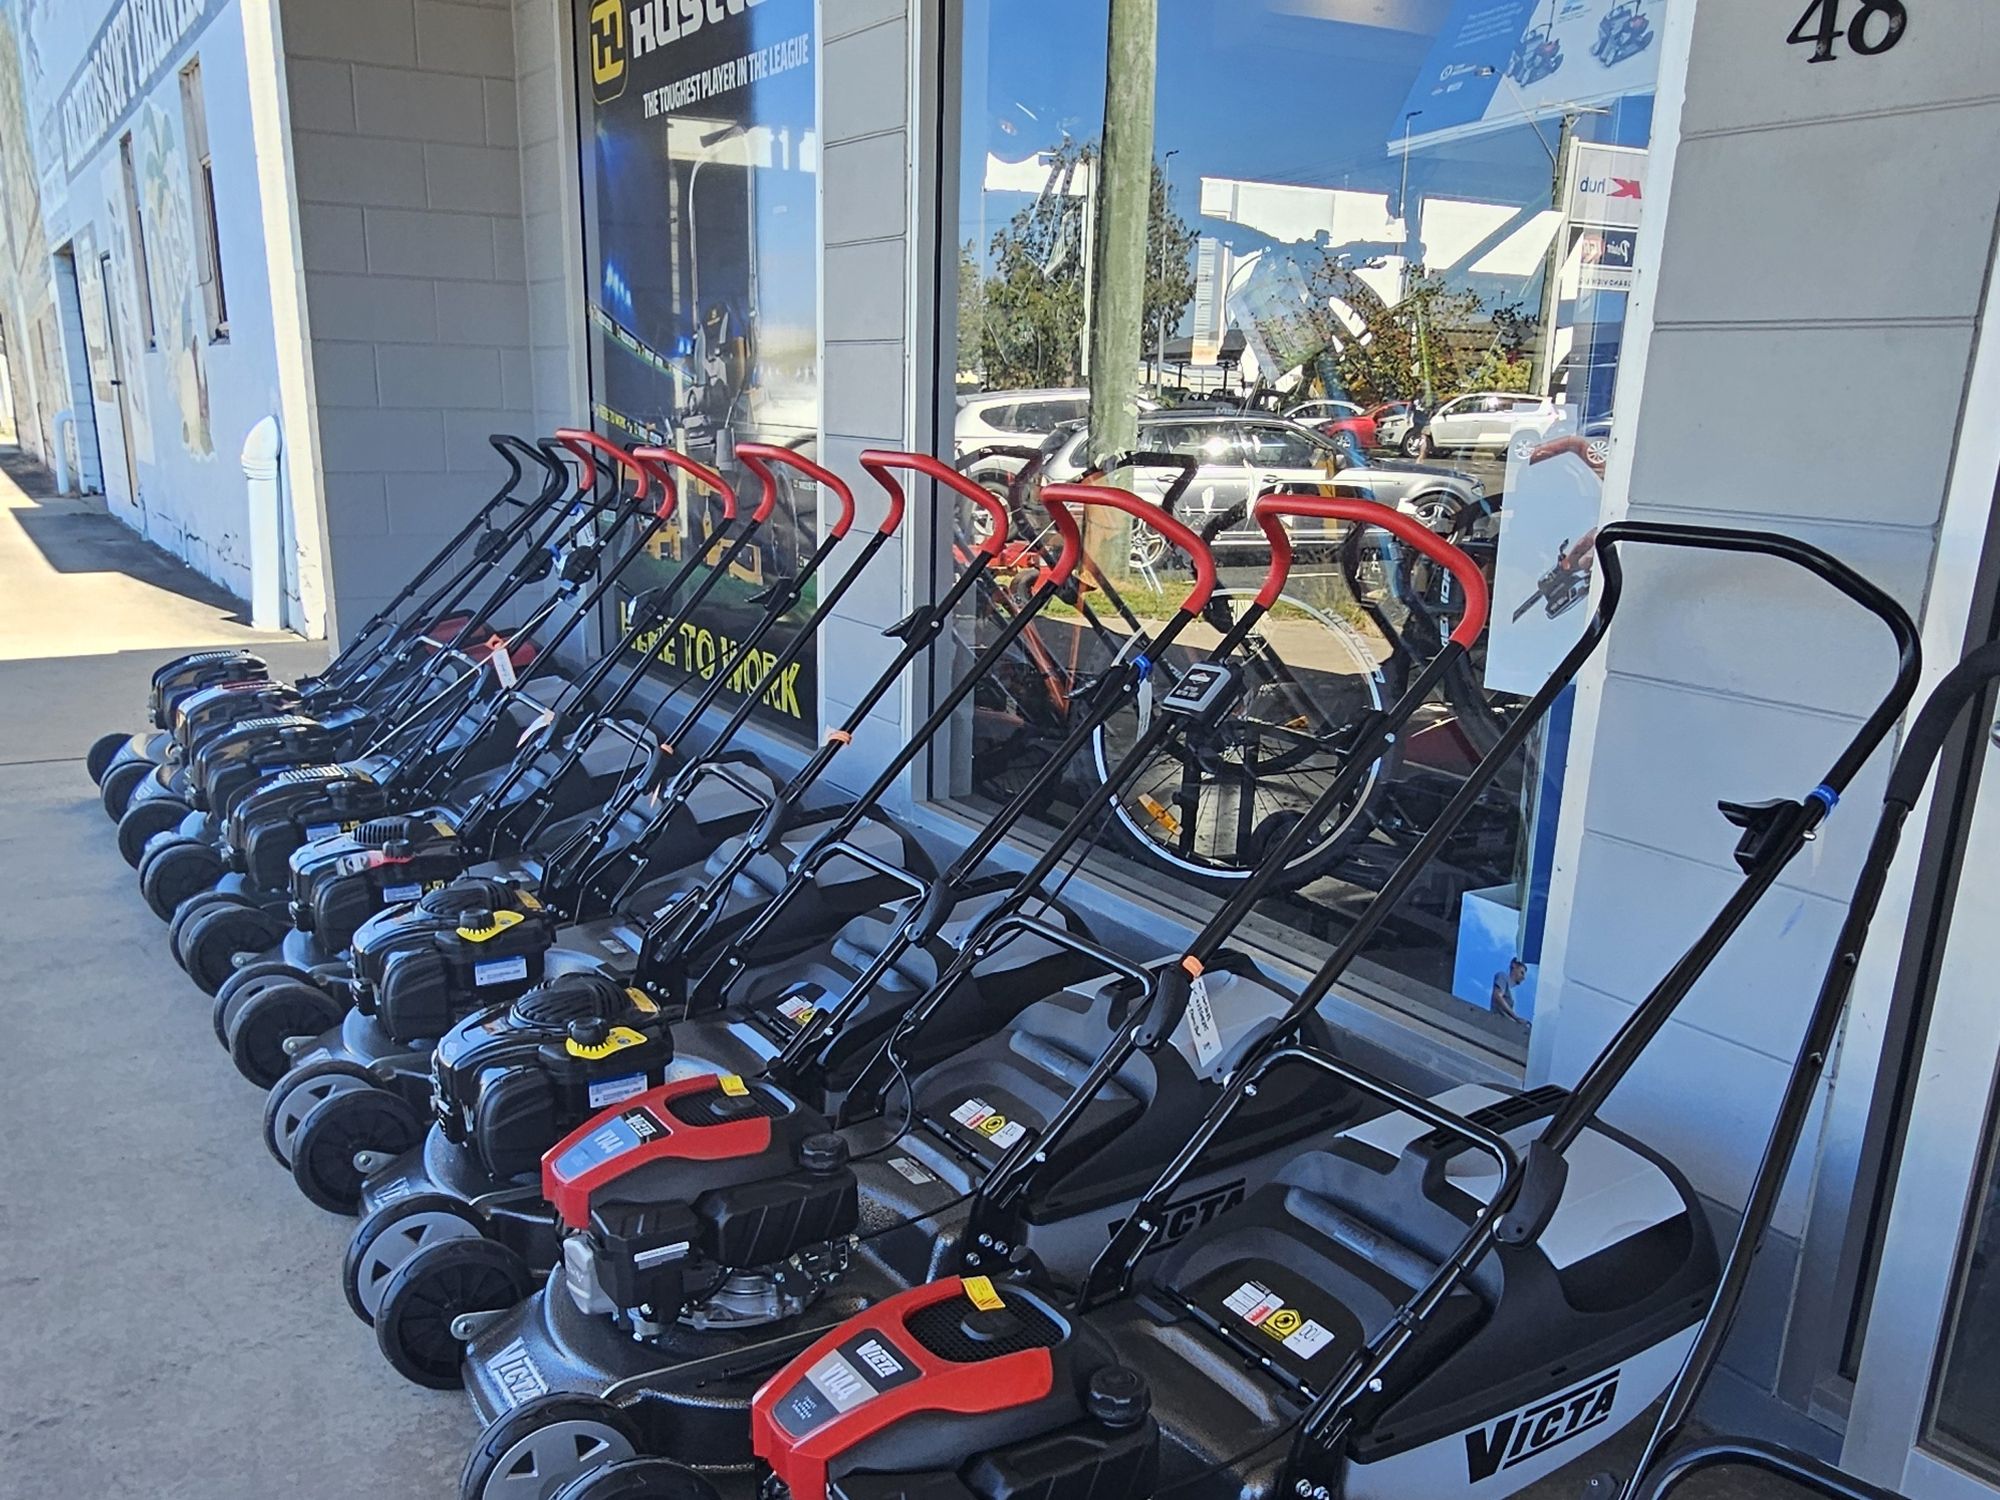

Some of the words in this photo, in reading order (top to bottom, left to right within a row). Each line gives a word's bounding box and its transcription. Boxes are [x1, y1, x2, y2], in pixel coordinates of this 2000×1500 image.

[643, 89, 659, 119] THE
[659, 74, 701, 114] TOUGHEST
[701, 66, 736, 99] PLAYER
[736, 55, 748, 87] IN
[748, 49, 768, 82] THE
[769, 33, 809, 76] LEAGUE
[680, 622, 716, 681] TO
[720, 635, 802, 719] WORK
[818, 1362, 862, 1402] V144
[855, 1338, 903, 1378] VICTA
[1464, 1369, 1622, 1484] VICTA
